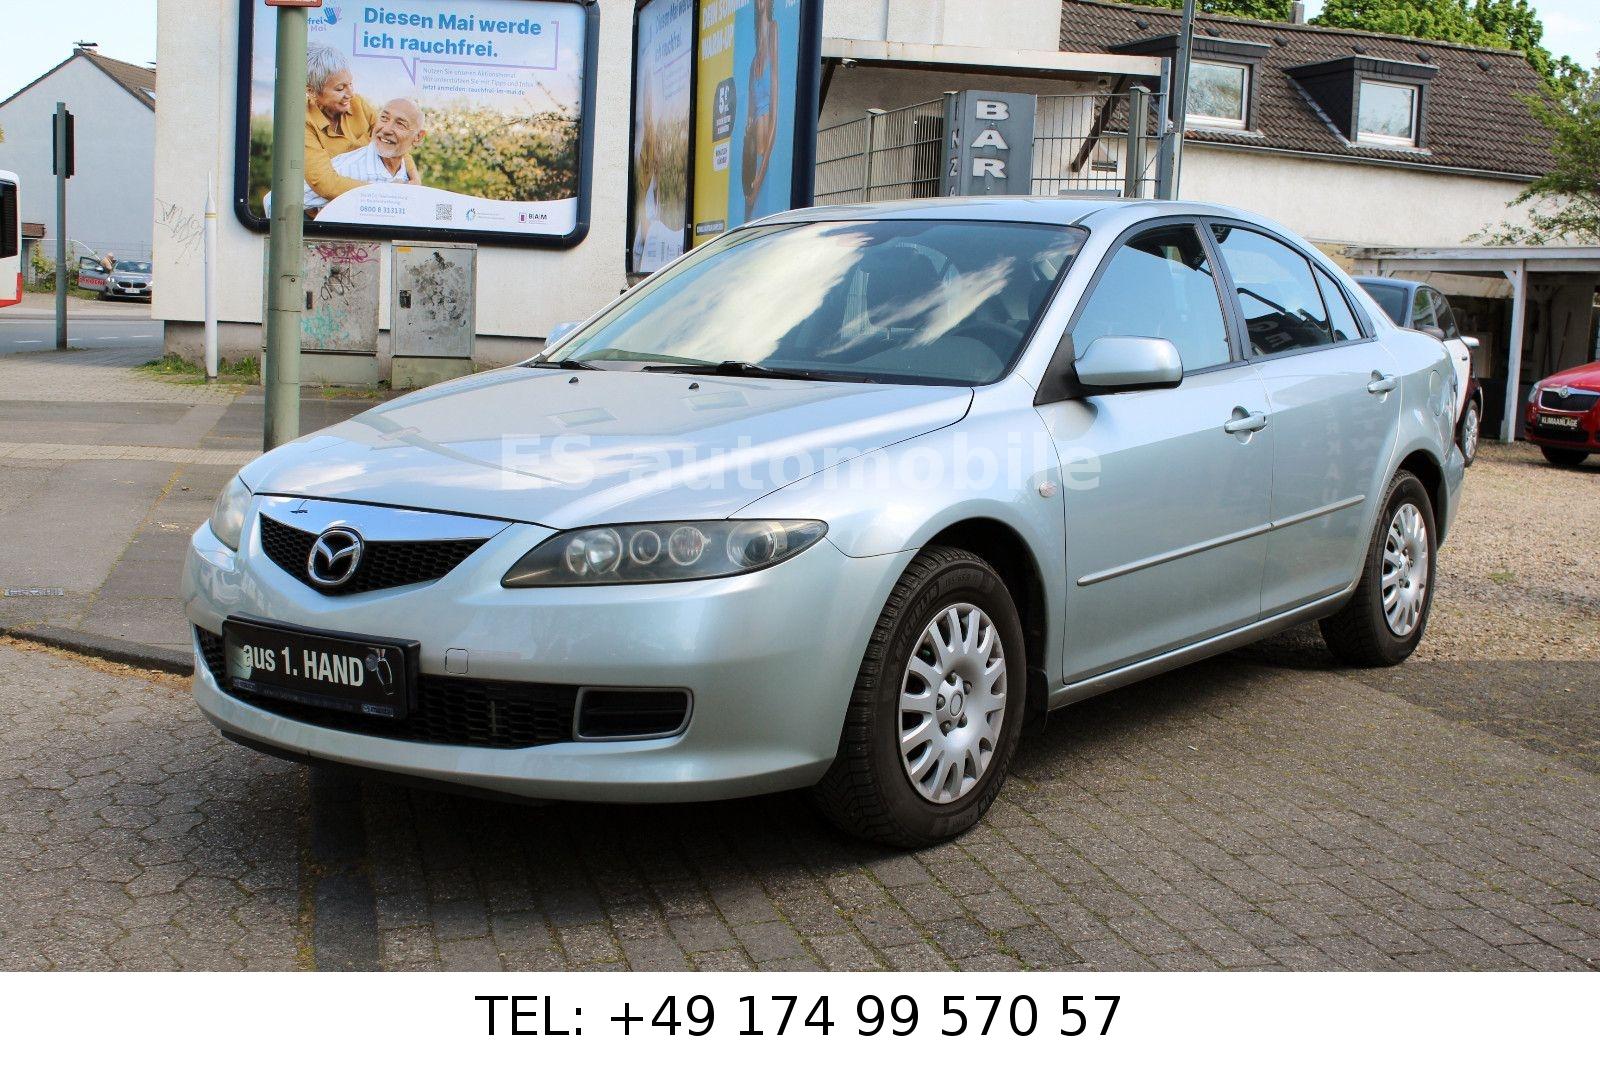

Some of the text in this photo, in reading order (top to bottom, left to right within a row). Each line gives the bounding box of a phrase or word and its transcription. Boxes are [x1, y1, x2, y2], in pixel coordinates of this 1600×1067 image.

[364, 7, 541, 35] Diesen Mai werde
[363, 31, 498, 57] ich rauchfrei.
[971, 99, 1010, 179] BAR
[360, 205, 376, 213] 0800
[243, 644, 364, 687] aus 1. HAND
